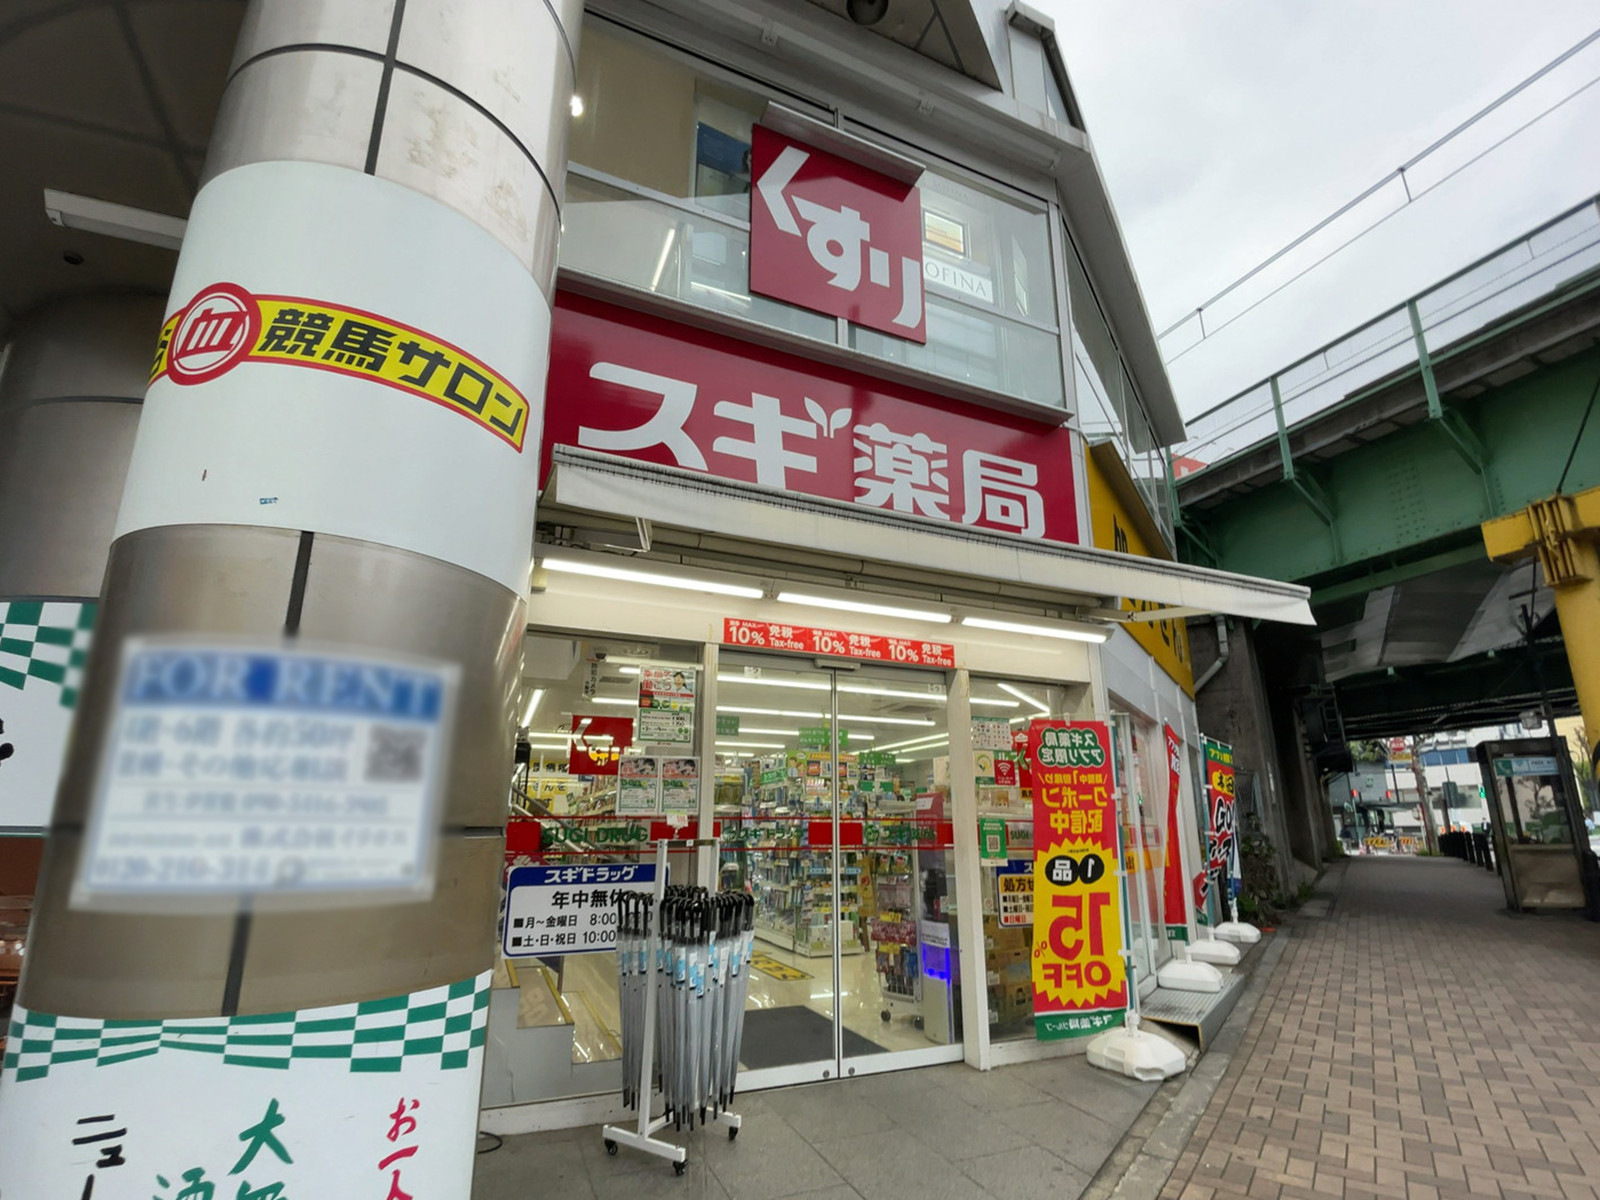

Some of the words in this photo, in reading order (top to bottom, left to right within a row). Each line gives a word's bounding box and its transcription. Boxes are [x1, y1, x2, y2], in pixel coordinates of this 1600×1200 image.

[757, 145, 921, 328] くすり
[925, 261, 987, 297] OFINA
[258, 308, 523, 437] 競馬サロン
[578, 361, 1045, 539] スギ薬局
[729, 626, 765, 646] 10%
[769, 625, 793, 639] 免税
[769, 637, 804, 650] Tax-free
[812, 635, 845, 654] 10%
[848, 634, 871, 648] 免税
[849, 646, 881, 659] Tax-free
[888, 645, 919, 662] 10%
[921, 643, 942, 656] 免税
[922, 654, 952, 667] Tax-free
[543, 827, 589, 844] SUGI
[597, 827, 648, 843] DRUG
[544, 865, 639, 883] スギドラッグ
[551, 888, 625, 910] 年中無休
